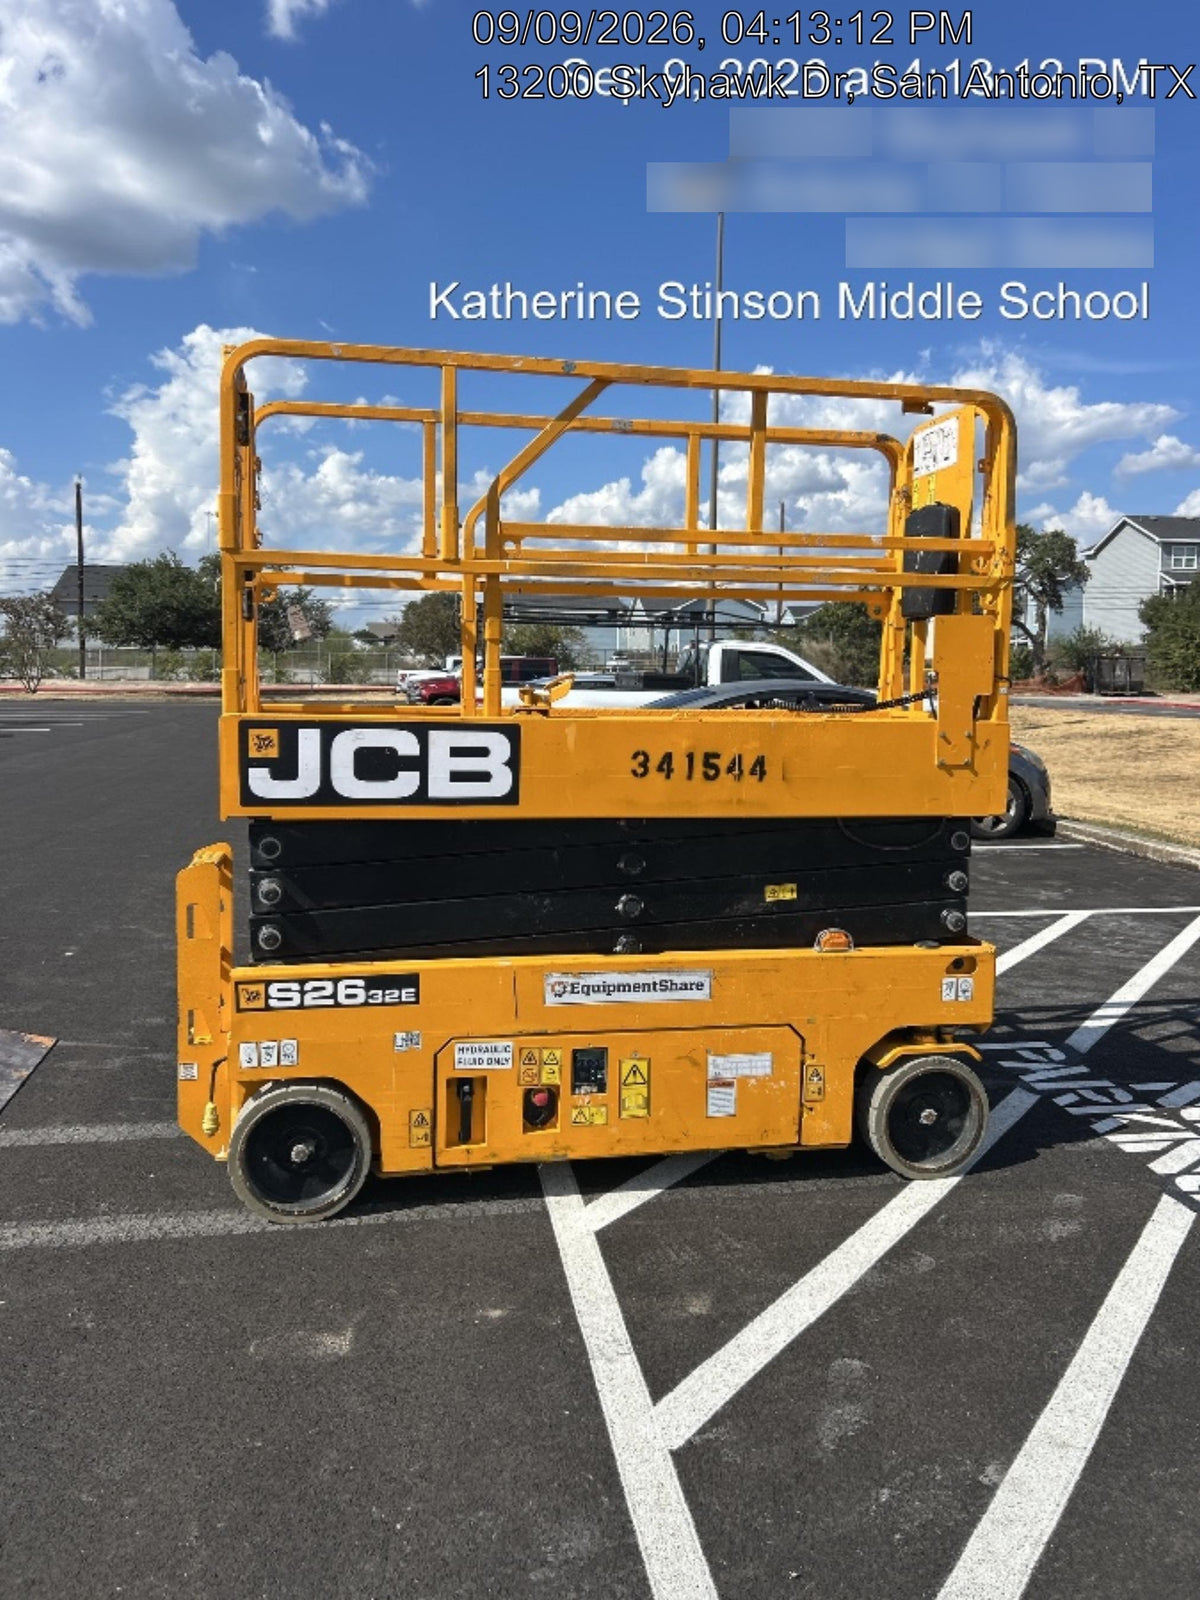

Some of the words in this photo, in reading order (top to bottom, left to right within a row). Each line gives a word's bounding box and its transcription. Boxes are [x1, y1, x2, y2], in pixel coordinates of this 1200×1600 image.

[248, 728, 513, 799] JCB
[631, 750, 767, 782] 341544
[570, 979, 706, 997] EquipmentShare
[486, 1057, 511, 1066] ONLY
